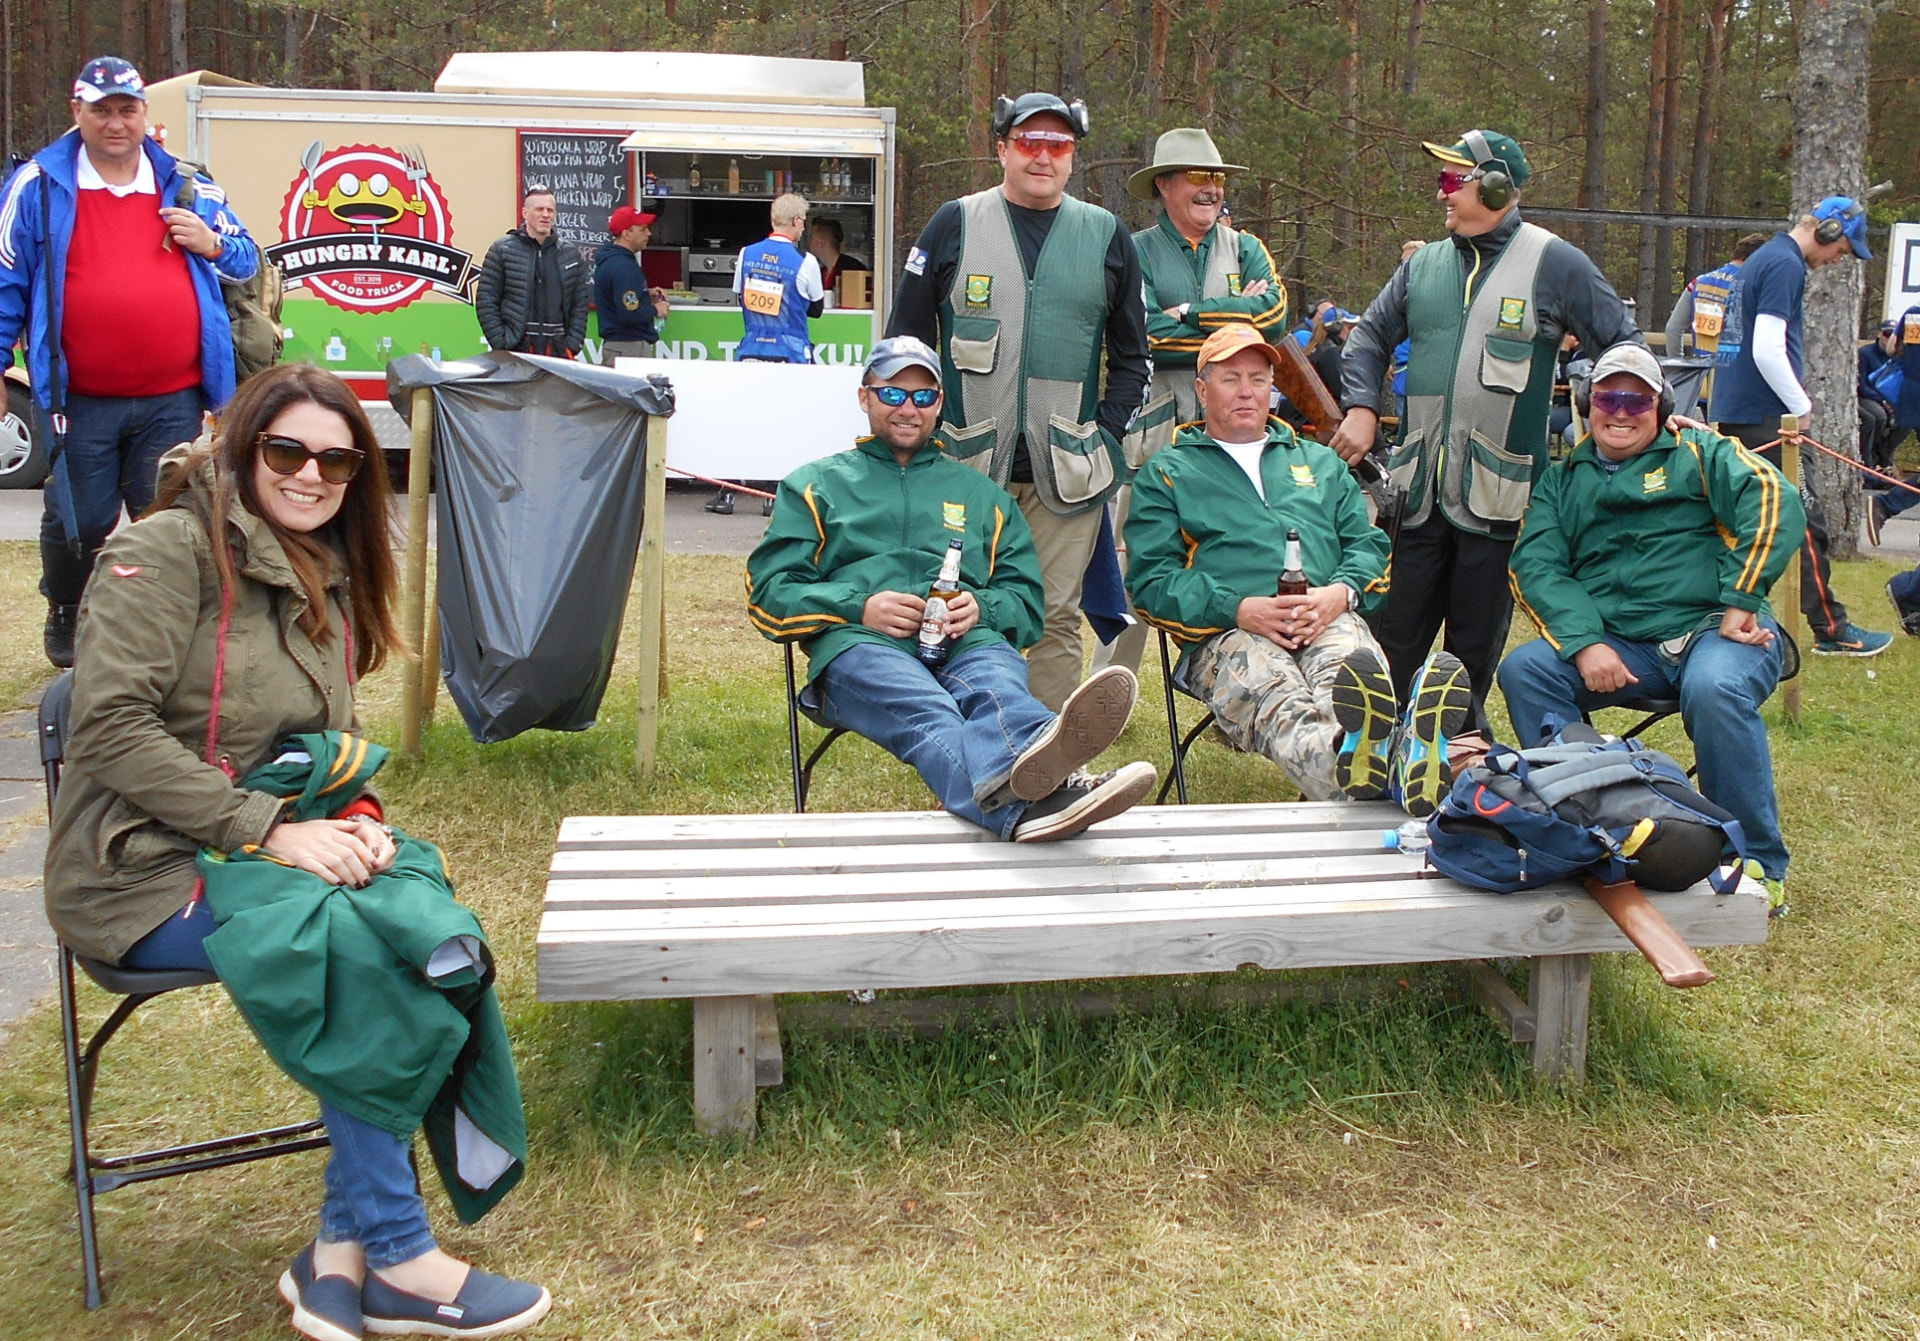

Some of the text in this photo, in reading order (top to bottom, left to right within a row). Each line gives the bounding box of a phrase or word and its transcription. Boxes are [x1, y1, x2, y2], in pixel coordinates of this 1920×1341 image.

[584, 140, 607, 154] WRAP
[525, 154, 608, 167] SMOKED FISH WRAP
[554, 173, 579, 190] KANA
[581, 171, 606, 189] WRAP
[591, 191, 614, 208] WRAP
[553, 212, 589, 228] URGER
[282, 244, 451, 275] HUNGRY KARL
[762, 253, 779, 265] FIN
[331, 279, 405, 297] FOOD TRUCK
[750, 293, 775, 310] 209
